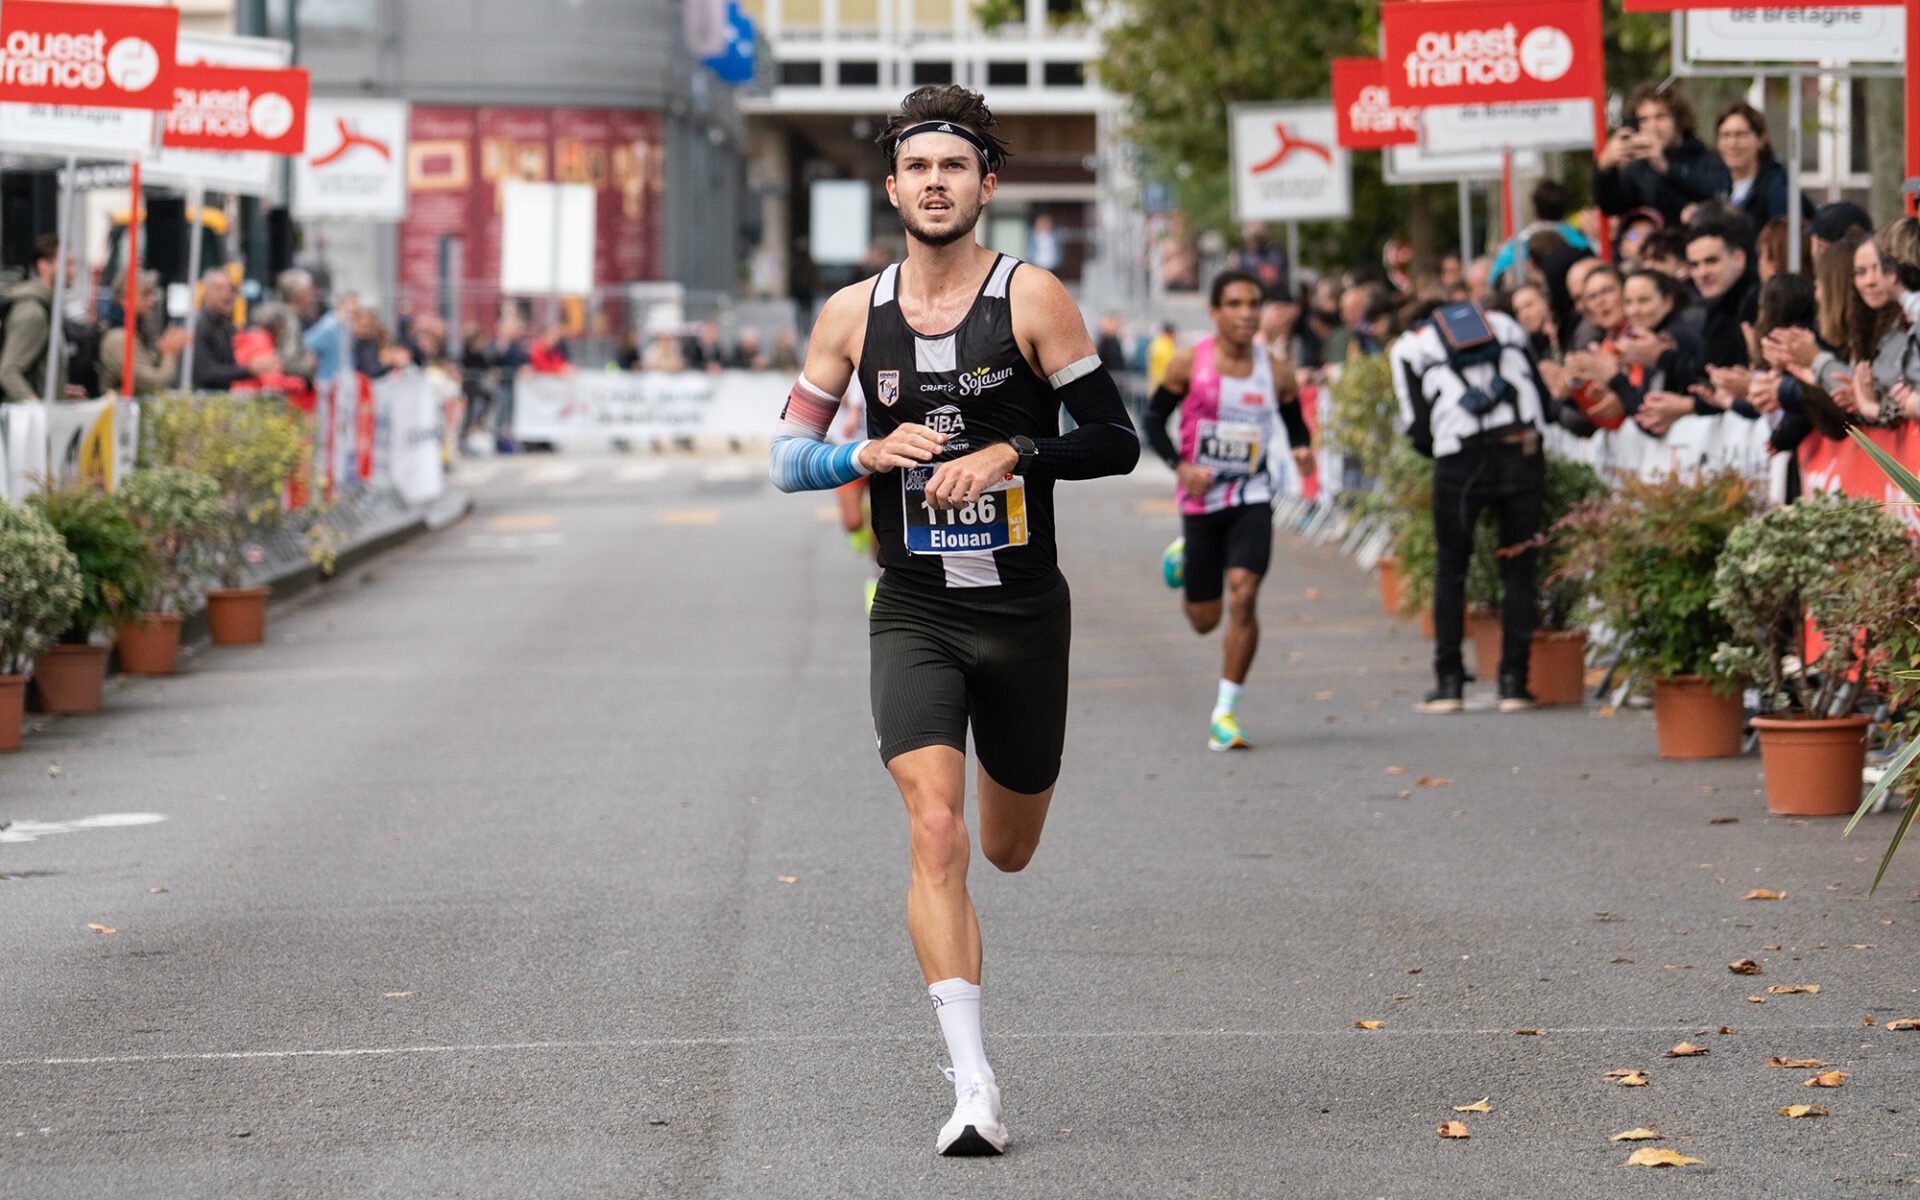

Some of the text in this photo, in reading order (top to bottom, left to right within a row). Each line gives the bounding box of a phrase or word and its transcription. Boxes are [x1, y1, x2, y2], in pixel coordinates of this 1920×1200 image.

[6, 29, 106, 60] ouest
[1416, 22, 1518, 60] ouest
[1404, 52, 1520, 87] france
[920, 383, 948, 392] CRAFT
[958, 366, 1014, 396] Sojasun
[924, 413, 966, 434] HBA
[921, 493, 996, 525] 1186
[930, 530, 992, 548] Elouan
[1012, 524, 1021, 540] 1
